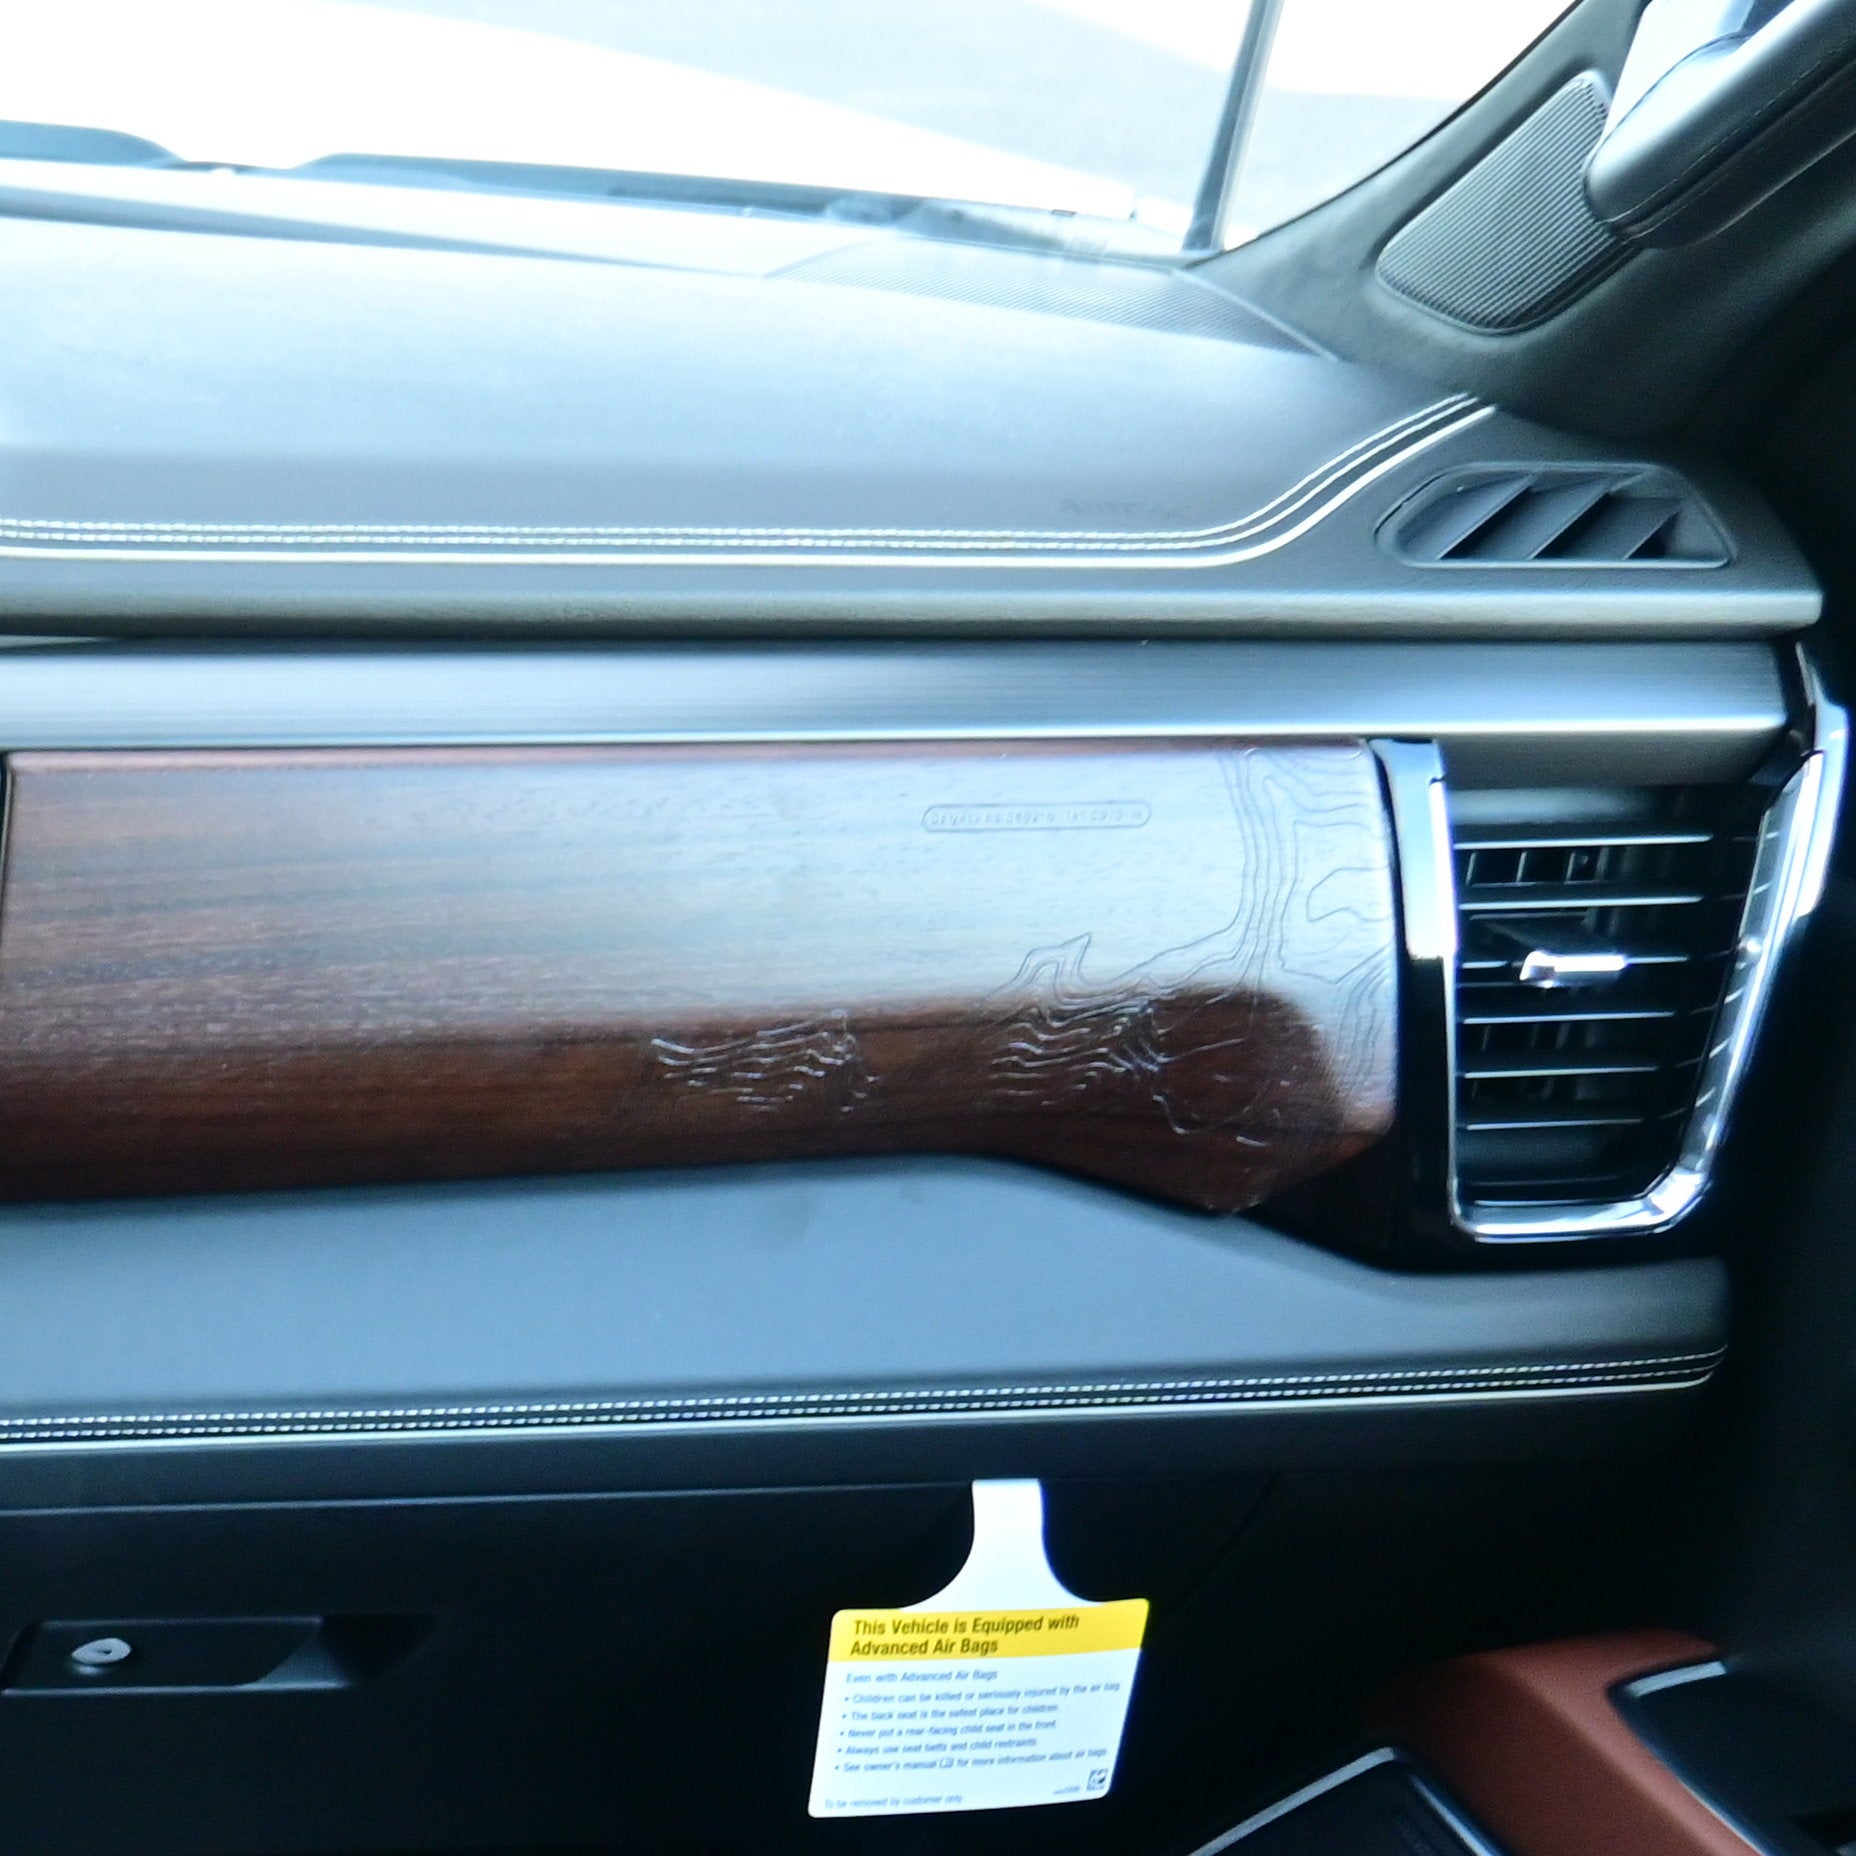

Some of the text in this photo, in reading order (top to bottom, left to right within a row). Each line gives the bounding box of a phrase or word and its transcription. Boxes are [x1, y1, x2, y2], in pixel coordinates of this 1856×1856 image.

[854, 1613, 1080, 1636] This Vehicle is Equipped with
[849, 1637, 999, 1657] Advanced Air Bags
[846, 1669, 998, 1684] Even with Advanced Air Bags
